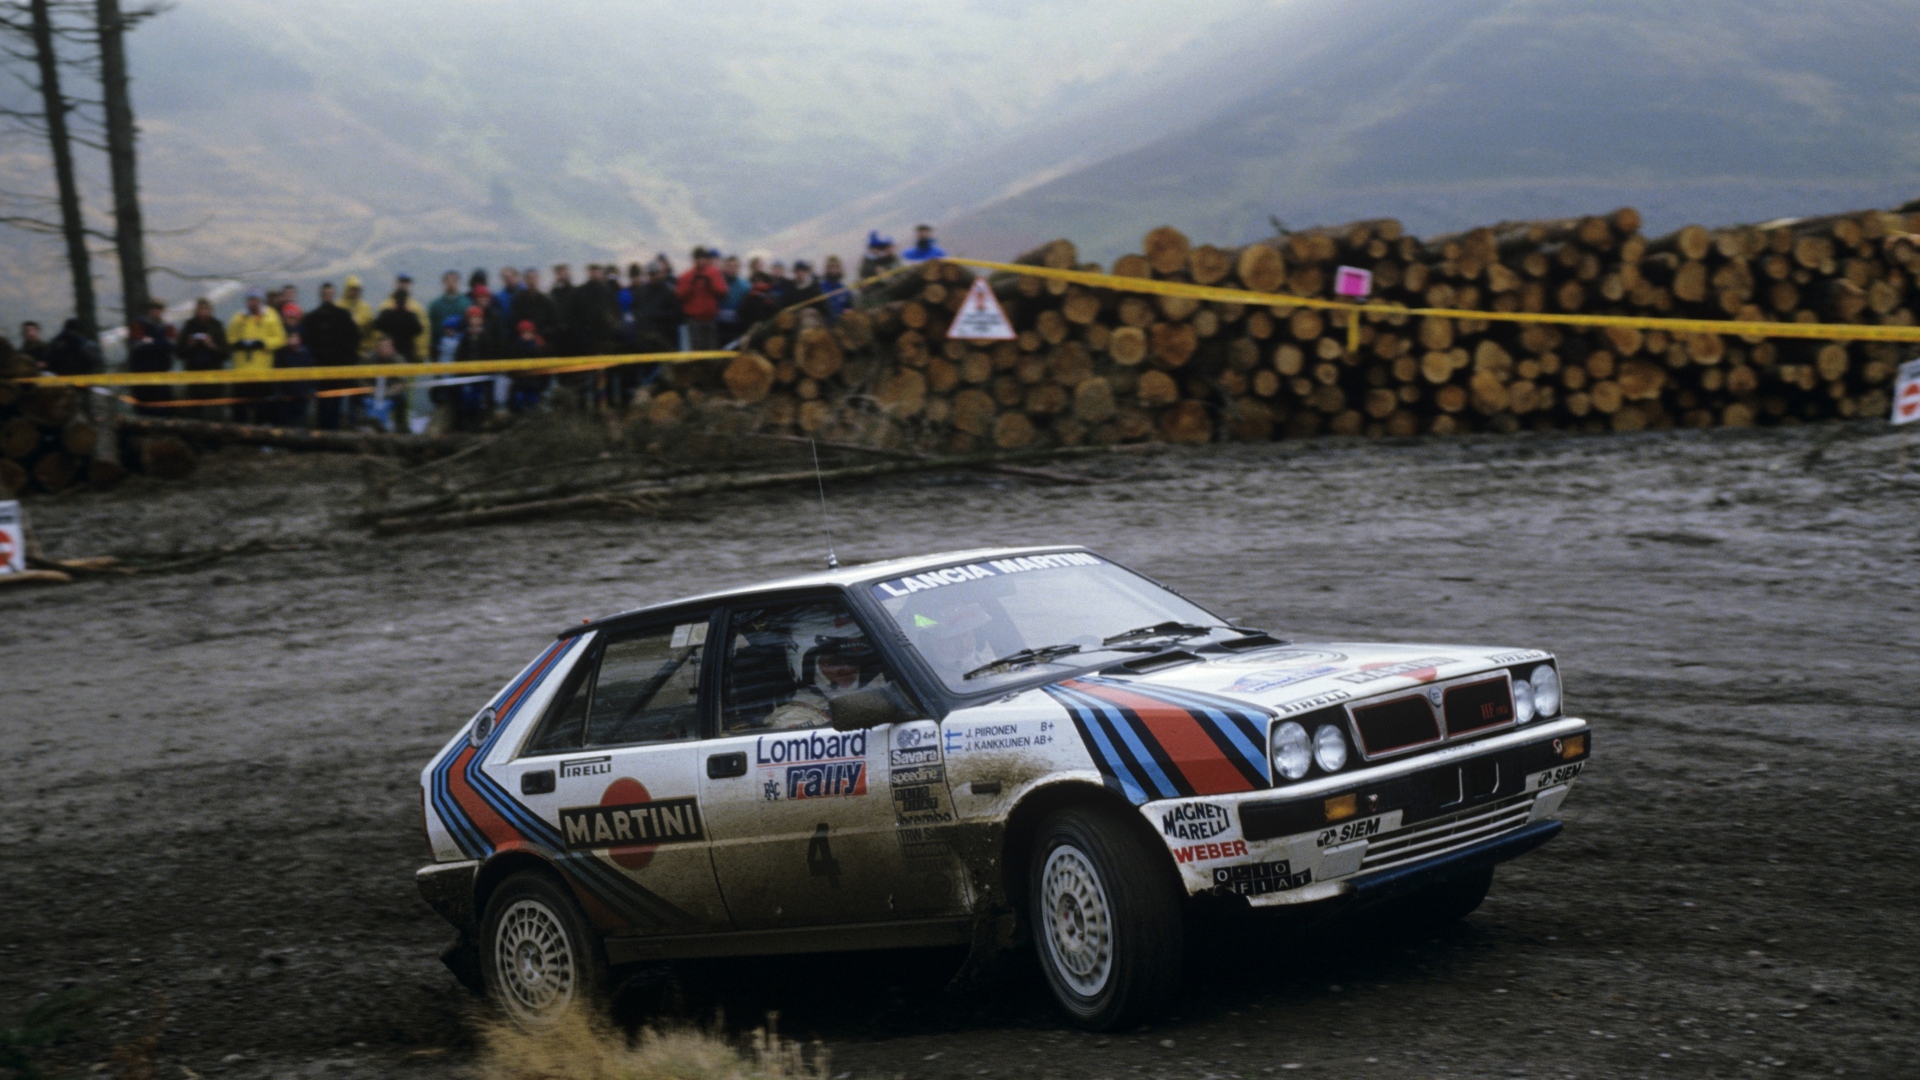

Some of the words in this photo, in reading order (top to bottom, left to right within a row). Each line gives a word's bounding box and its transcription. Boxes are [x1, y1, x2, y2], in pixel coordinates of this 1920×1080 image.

[879, 564, 996, 597] LANCIA
[989, 552, 1101, 575] MARTINI
[1486, 651, 1543, 664] PIRELLI
[1274, 689, 1352, 713] PIRELLI
[965, 729, 974, 739] J.
[974, 724, 1017, 737] PIIRONEN
[1040, 722, 1054, 732] B+
[757, 729, 867, 764] Lombard
[965, 742, 973, 752] J.
[974, 736, 1031, 751] KANKKUNEN
[1034, 735, 1054, 746] AB+
[560, 755, 612, 778] PIRELLI
[892, 749, 937, 766] Savara
[788, 762, 864, 798] rally
[892, 767, 938, 786] speedline
[1553, 762, 1582, 784] SIEM
[895, 787, 929, 800] OLIO
[904, 797, 938, 811] FIAT
[564, 803, 697, 844] MARTINI
[898, 809, 952, 825] brembo
[1162, 802, 1230, 828] MAGNETI
[1163, 814, 1230, 840] MARELLI
[1340, 817, 1381, 841] SIEM
[807, 823, 841, 889] 4
[1173, 840, 1248, 864] WEBER
[1240, 872, 1307, 894] FIAT
